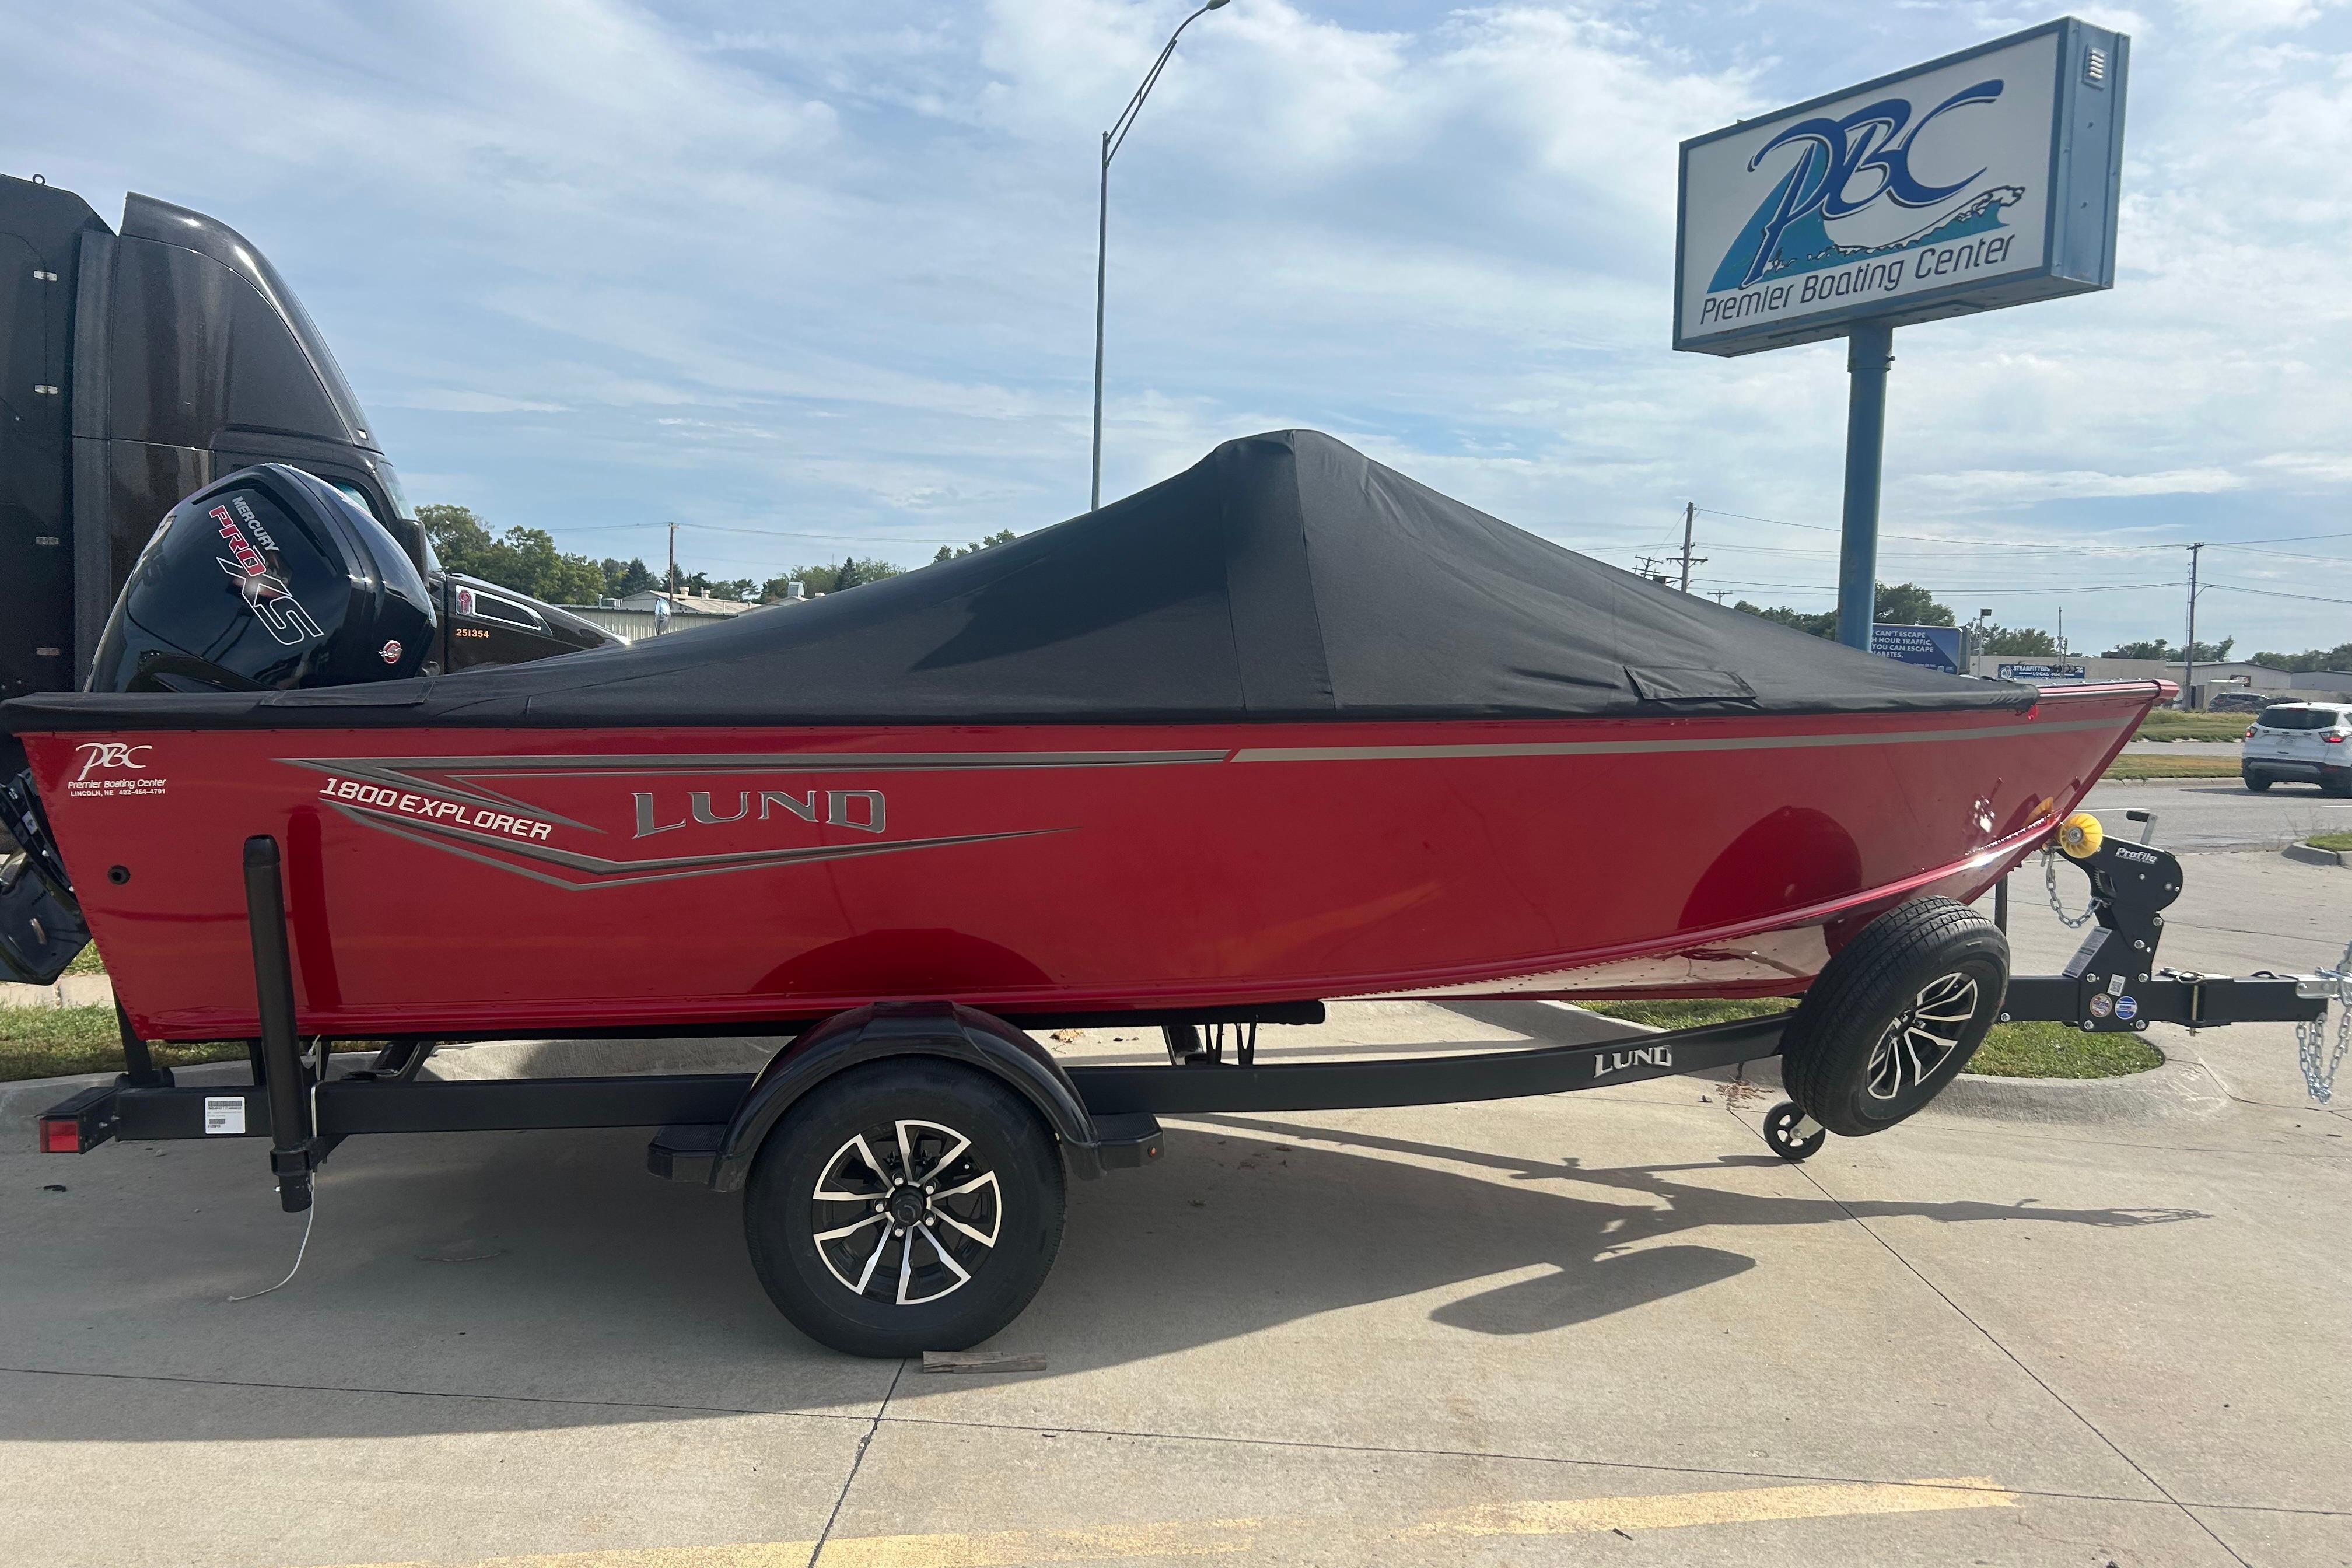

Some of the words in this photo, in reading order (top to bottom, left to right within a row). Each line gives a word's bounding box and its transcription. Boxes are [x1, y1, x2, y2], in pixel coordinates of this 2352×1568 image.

[1739, 79, 2005, 290] PBC
[1700, 282, 1794, 325] Premier
[1800, 259, 1906, 303] Boating
[1914, 235, 2015, 279] Center
[208, 503, 267, 577] PRO
[232, 496, 280, 551] MERCURY
[456, 628, 489, 638] 251354
[68, 780, 102, 789] Premier
[104, 779, 135, 789] Boating
[75, 742, 153, 781] PBC
[318, 778, 399, 807] 1800
[398, 794, 552, 841] EXPLORER
[631, 790, 886, 840] LUND
[2116, 847, 2157, 862] Profile
[1594, 1045, 1672, 1079] LUND
